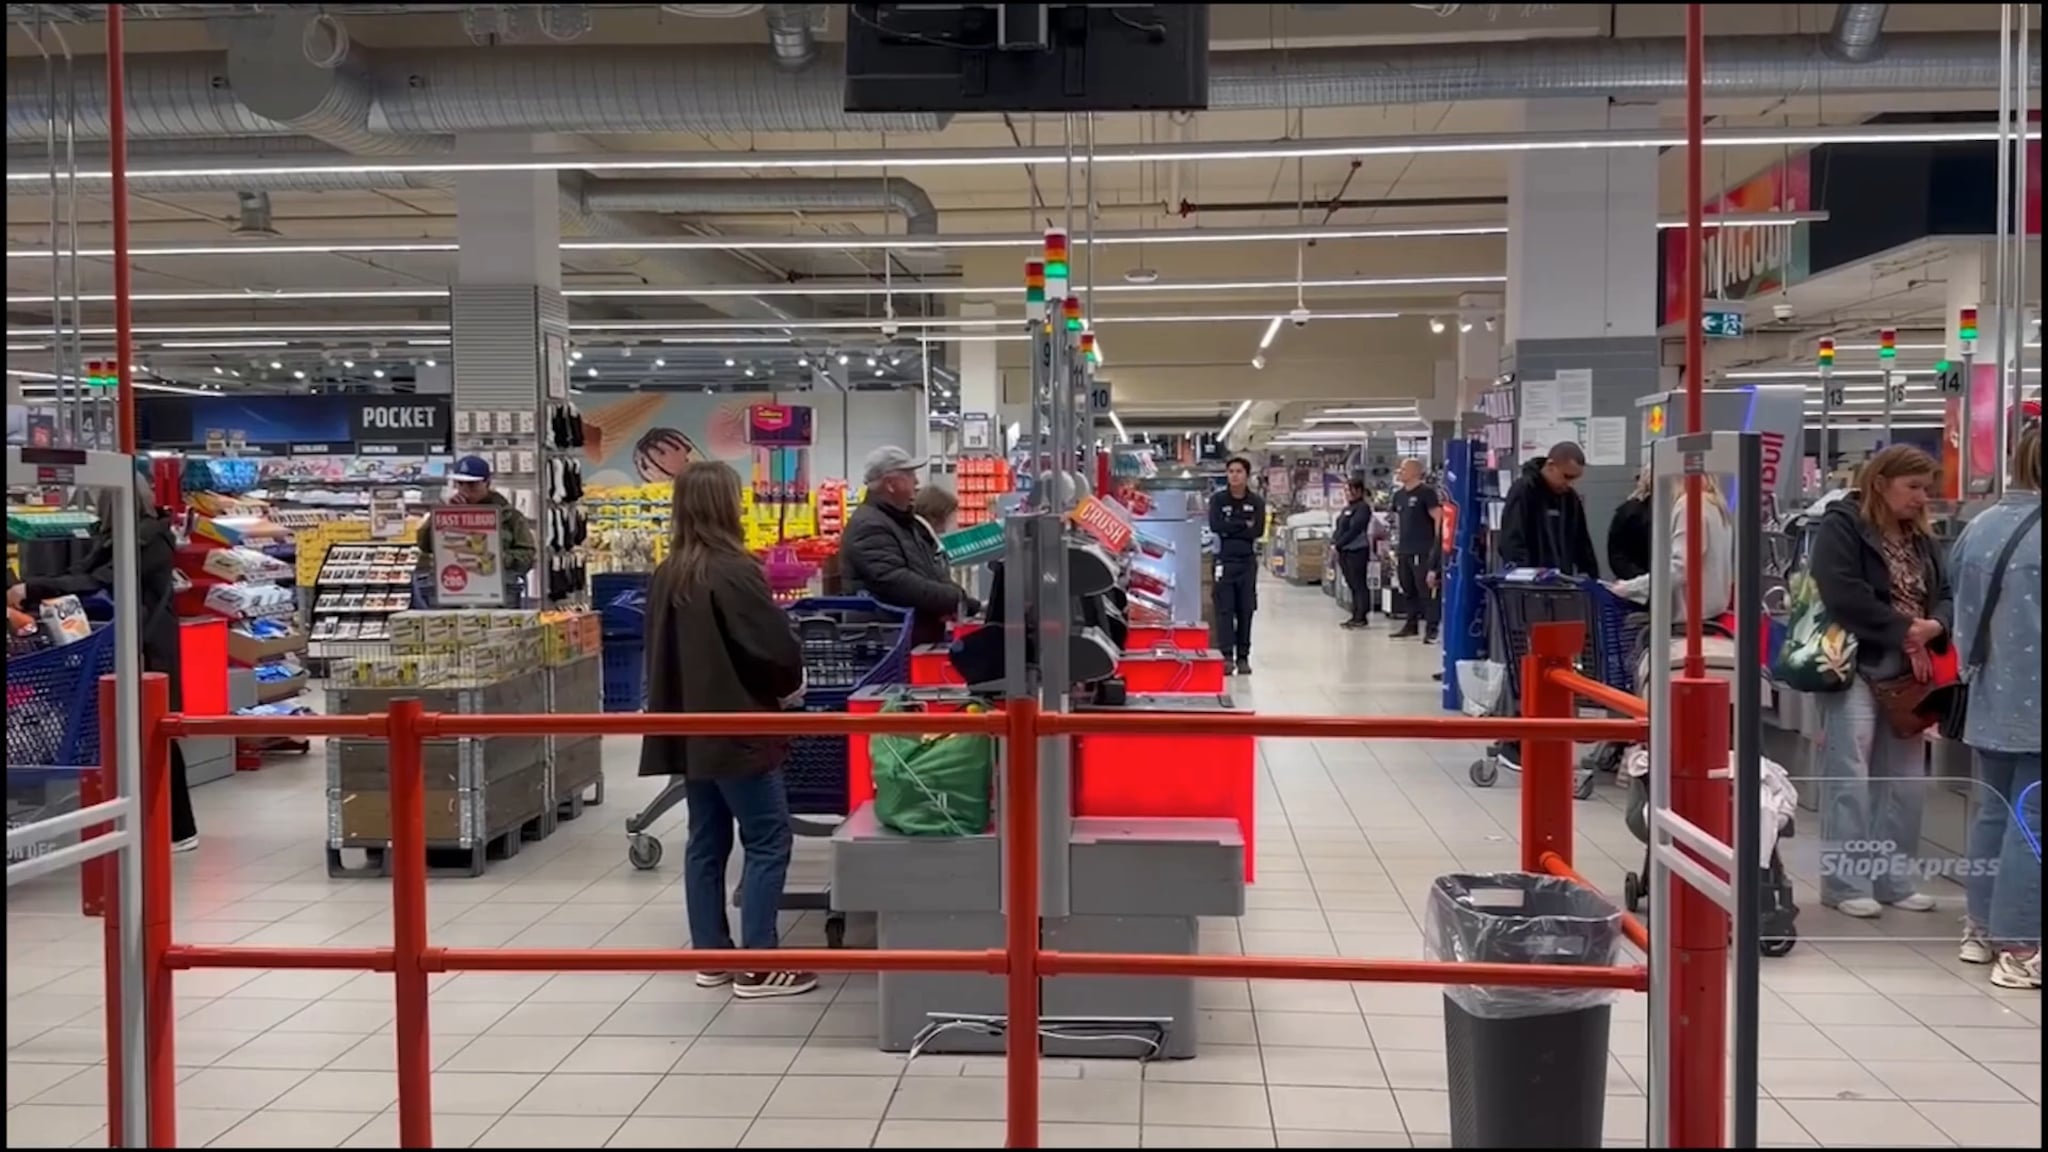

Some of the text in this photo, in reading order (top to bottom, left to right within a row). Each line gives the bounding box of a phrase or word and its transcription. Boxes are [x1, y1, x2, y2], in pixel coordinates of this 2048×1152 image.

[1938, 372, 1960, 392] 14
[1091, 389, 1109, 408] 10
[1829, 389, 1844, 406] 13
[362, 406, 437, 428] POCKET
[436, 512, 496, 527] FAST TILBUD
[1079, 502, 1127, 545] CRUSH
[1844, 839, 1897, 855] coop
[1820, 853, 2000, 881] ShopExpress
